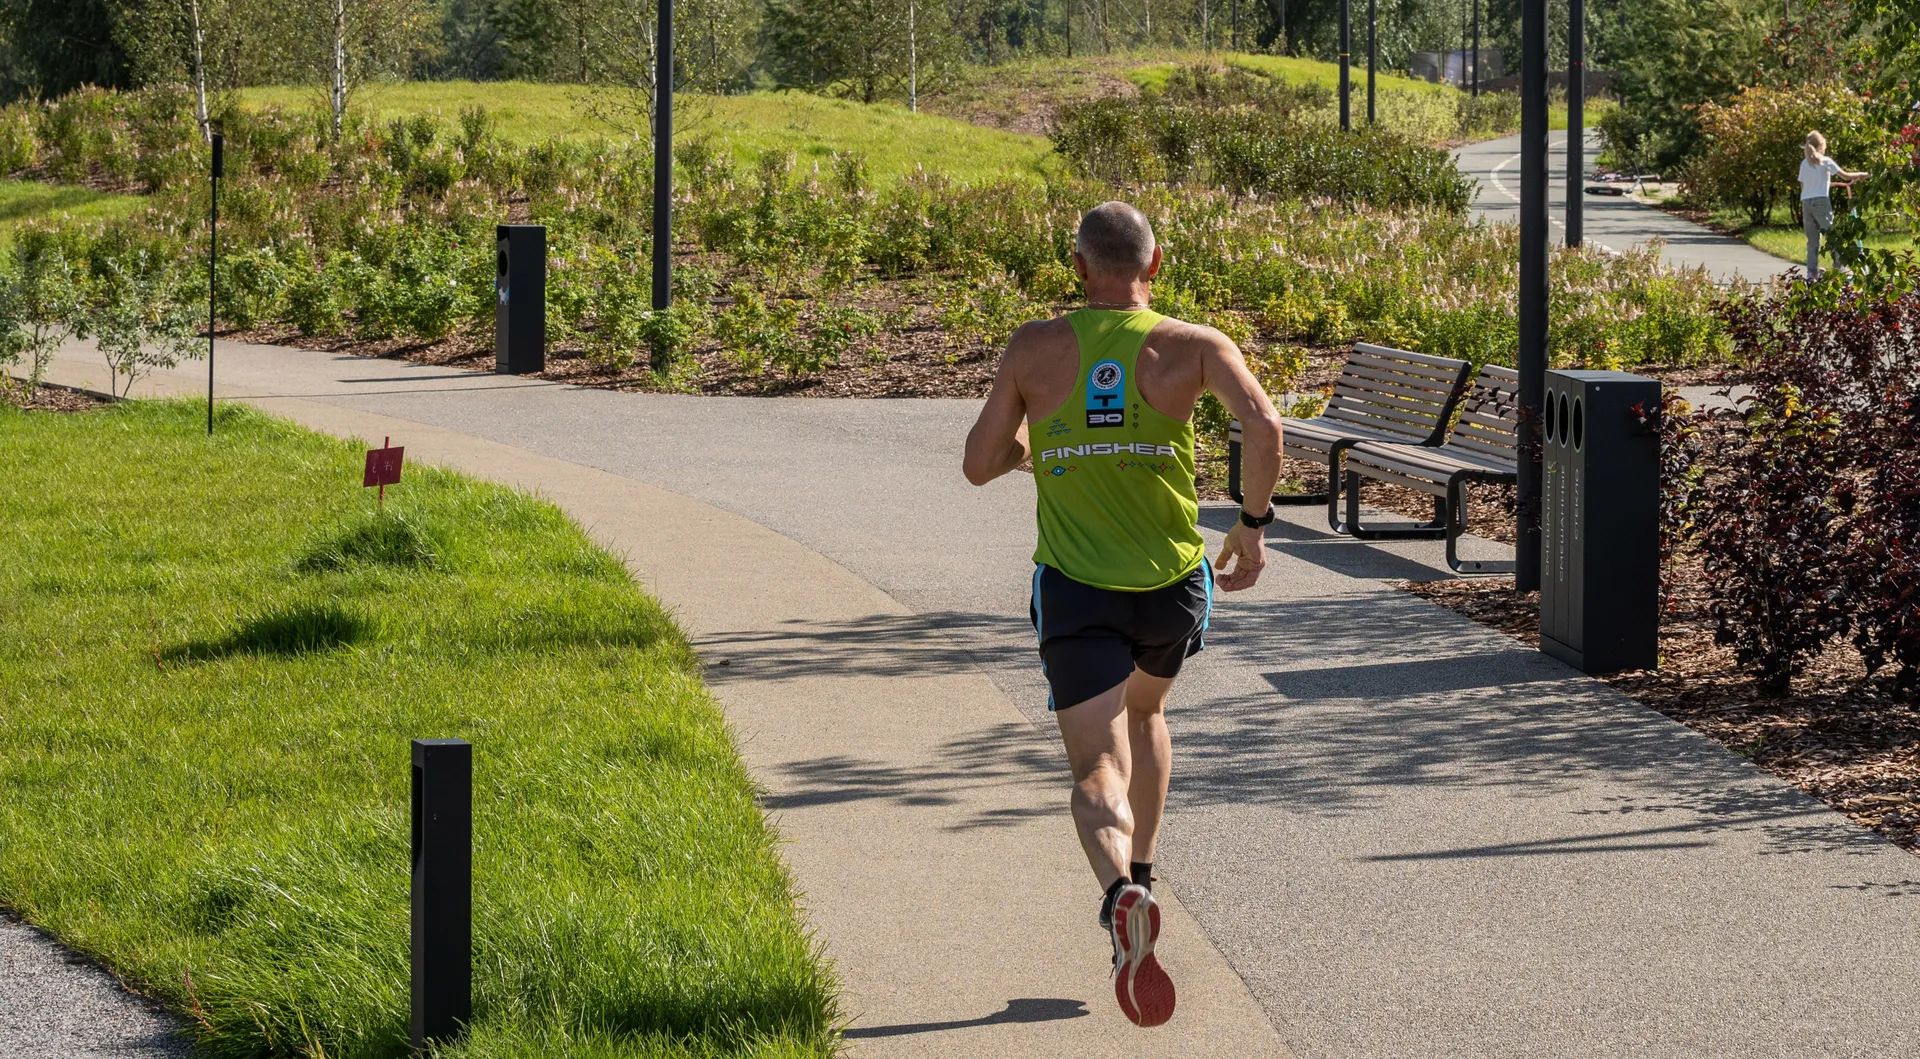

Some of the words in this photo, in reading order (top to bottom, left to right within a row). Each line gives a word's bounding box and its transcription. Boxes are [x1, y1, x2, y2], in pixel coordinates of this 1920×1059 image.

[1094, 394, 1118, 406] T
[1088, 413, 1123, 424] 30
[1041, 442, 1175, 462] FINISHER
